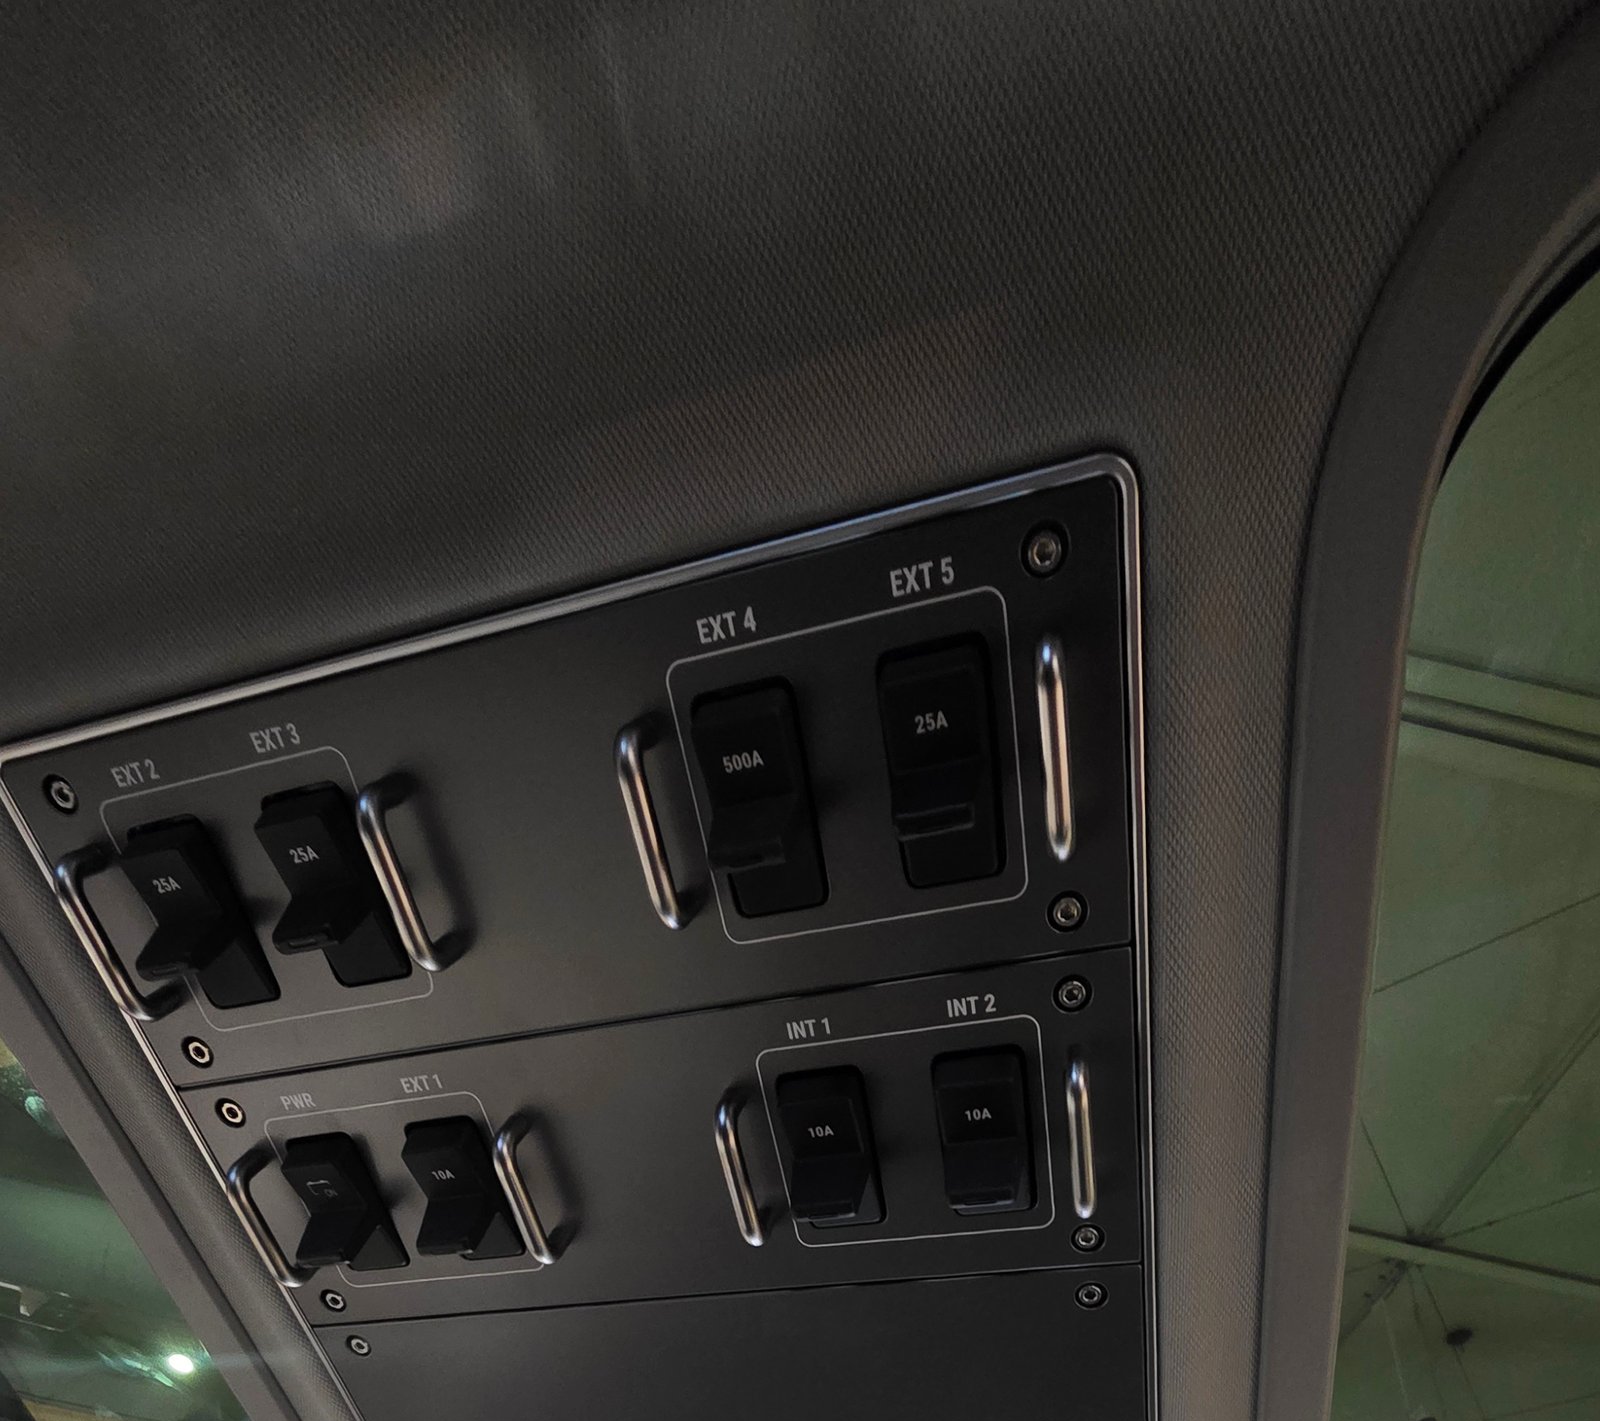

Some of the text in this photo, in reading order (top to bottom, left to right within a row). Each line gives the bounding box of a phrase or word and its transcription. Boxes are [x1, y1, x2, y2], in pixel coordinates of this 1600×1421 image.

[890, 556, 955, 598] EXT 5
[696, 606, 757, 645] EXT 4
[914, 710, 949, 734] 25A
[249, 722, 301, 754] EXT 3
[111, 758, 161, 788] EXT 2
[722, 750, 764, 773] 500A
[289, 845, 319, 865] 25A
[152, 877, 181, 894] 25A
[946, 993, 997, 1018] INT 2
[786, 1017, 831, 1040] INT 1
[399, 1073, 443, 1094] EXT 1
[280, 1092, 316, 1111] PWR
[964, 1107, 992, 1121] 10A
[807, 1125, 834, 1139] 10A
[431, 1168, 455, 1181] 10A
